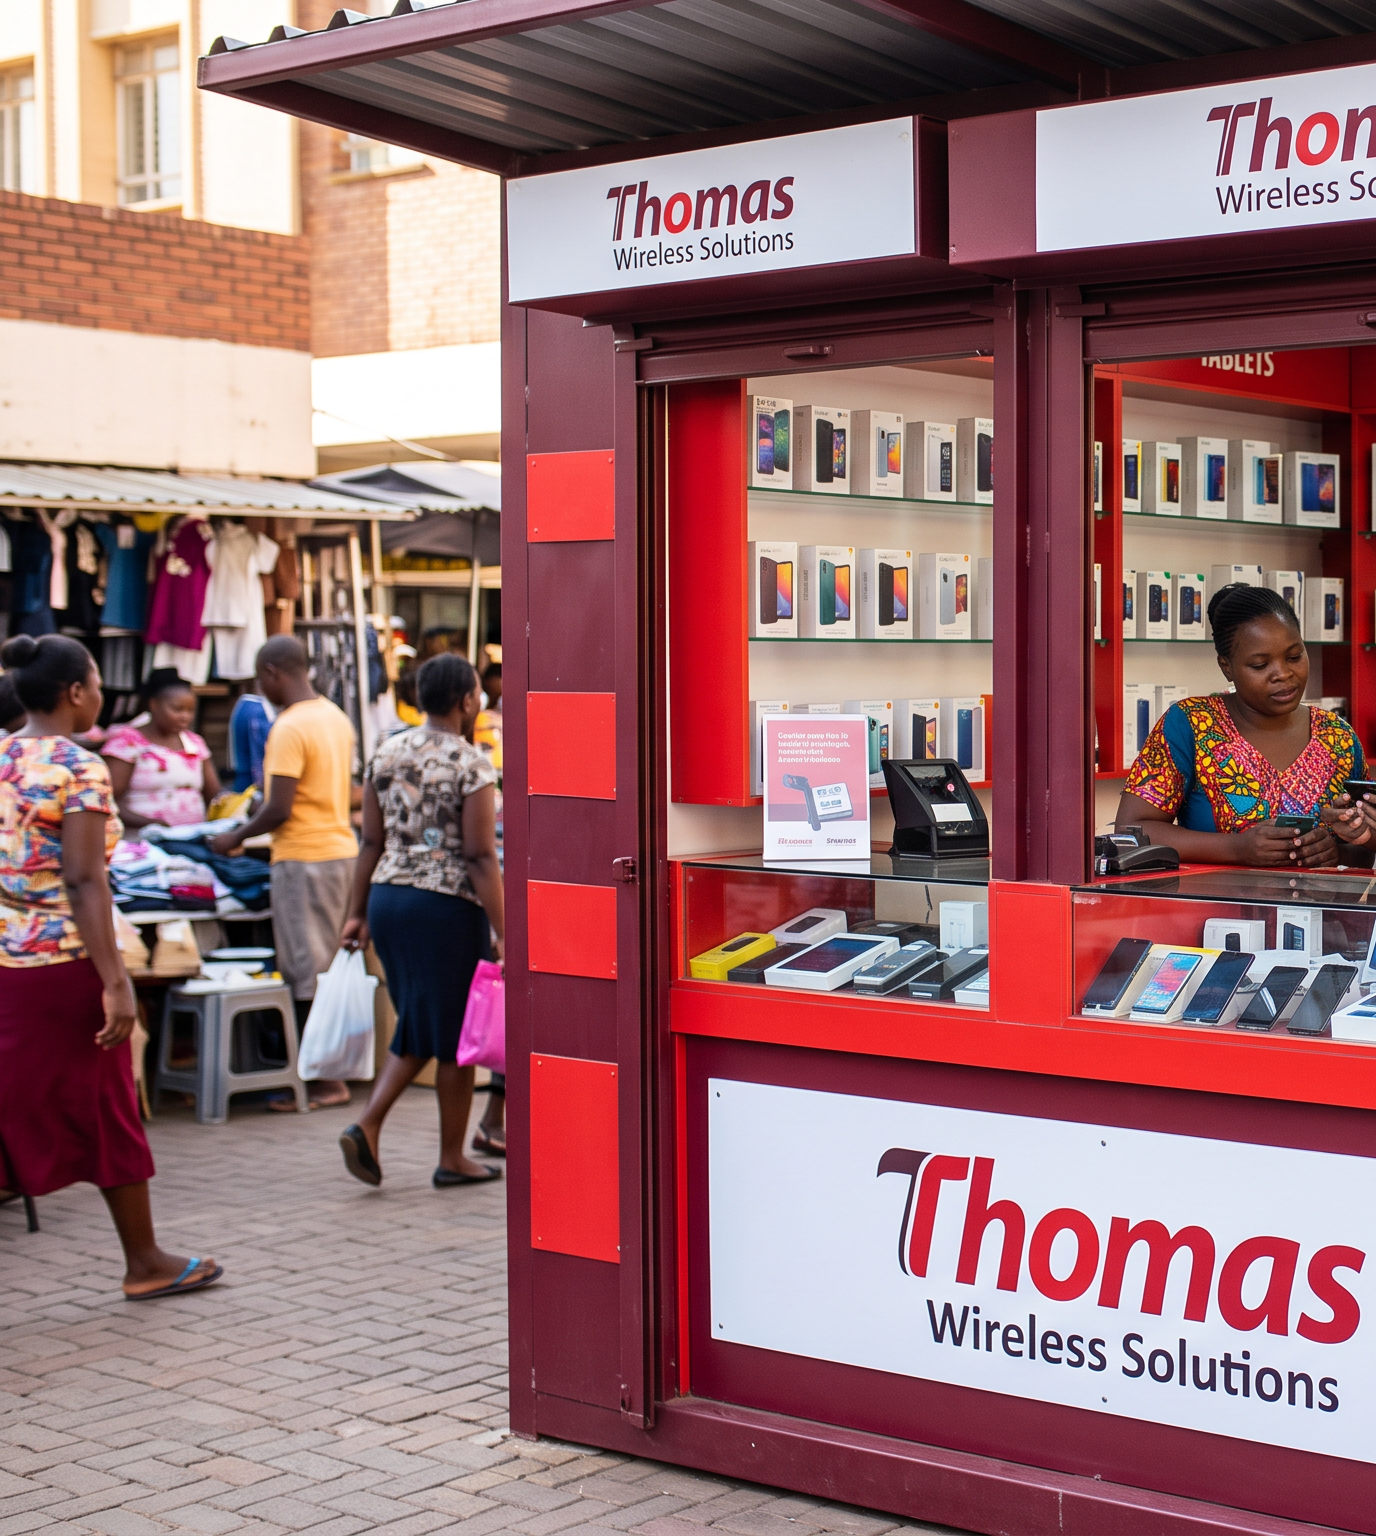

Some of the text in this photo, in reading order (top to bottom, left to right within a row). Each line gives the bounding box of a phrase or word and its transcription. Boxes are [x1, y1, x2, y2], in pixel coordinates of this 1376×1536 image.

[606, 176, 795, 242] Thomas
[1215, 176, 1340, 215] Wireless
[613, 231, 795, 271] Wireless Solutions
[876, 1147, 1367, 1345] Thomas
[926, 1299, 1340, 1413] Wireless Solutions
